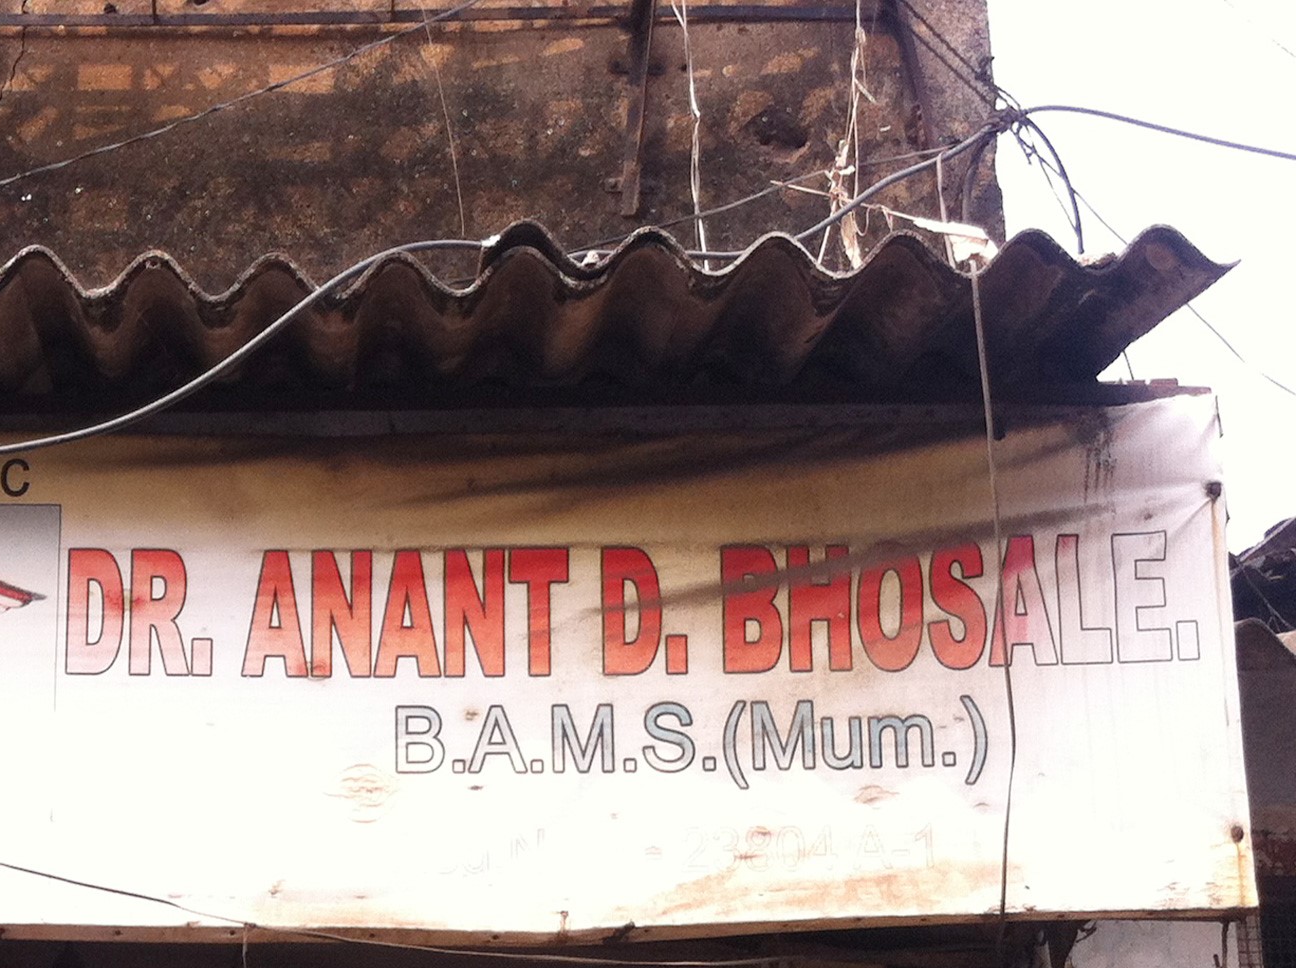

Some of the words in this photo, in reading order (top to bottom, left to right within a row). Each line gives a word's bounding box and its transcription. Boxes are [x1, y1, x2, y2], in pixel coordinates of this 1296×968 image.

[65, 548, 213, 676] DR.
[241, 547, 570, 679] ANANT
[600, 545, 689, 677] D.
[722, 530, 1202, 675] BHOSALE.
